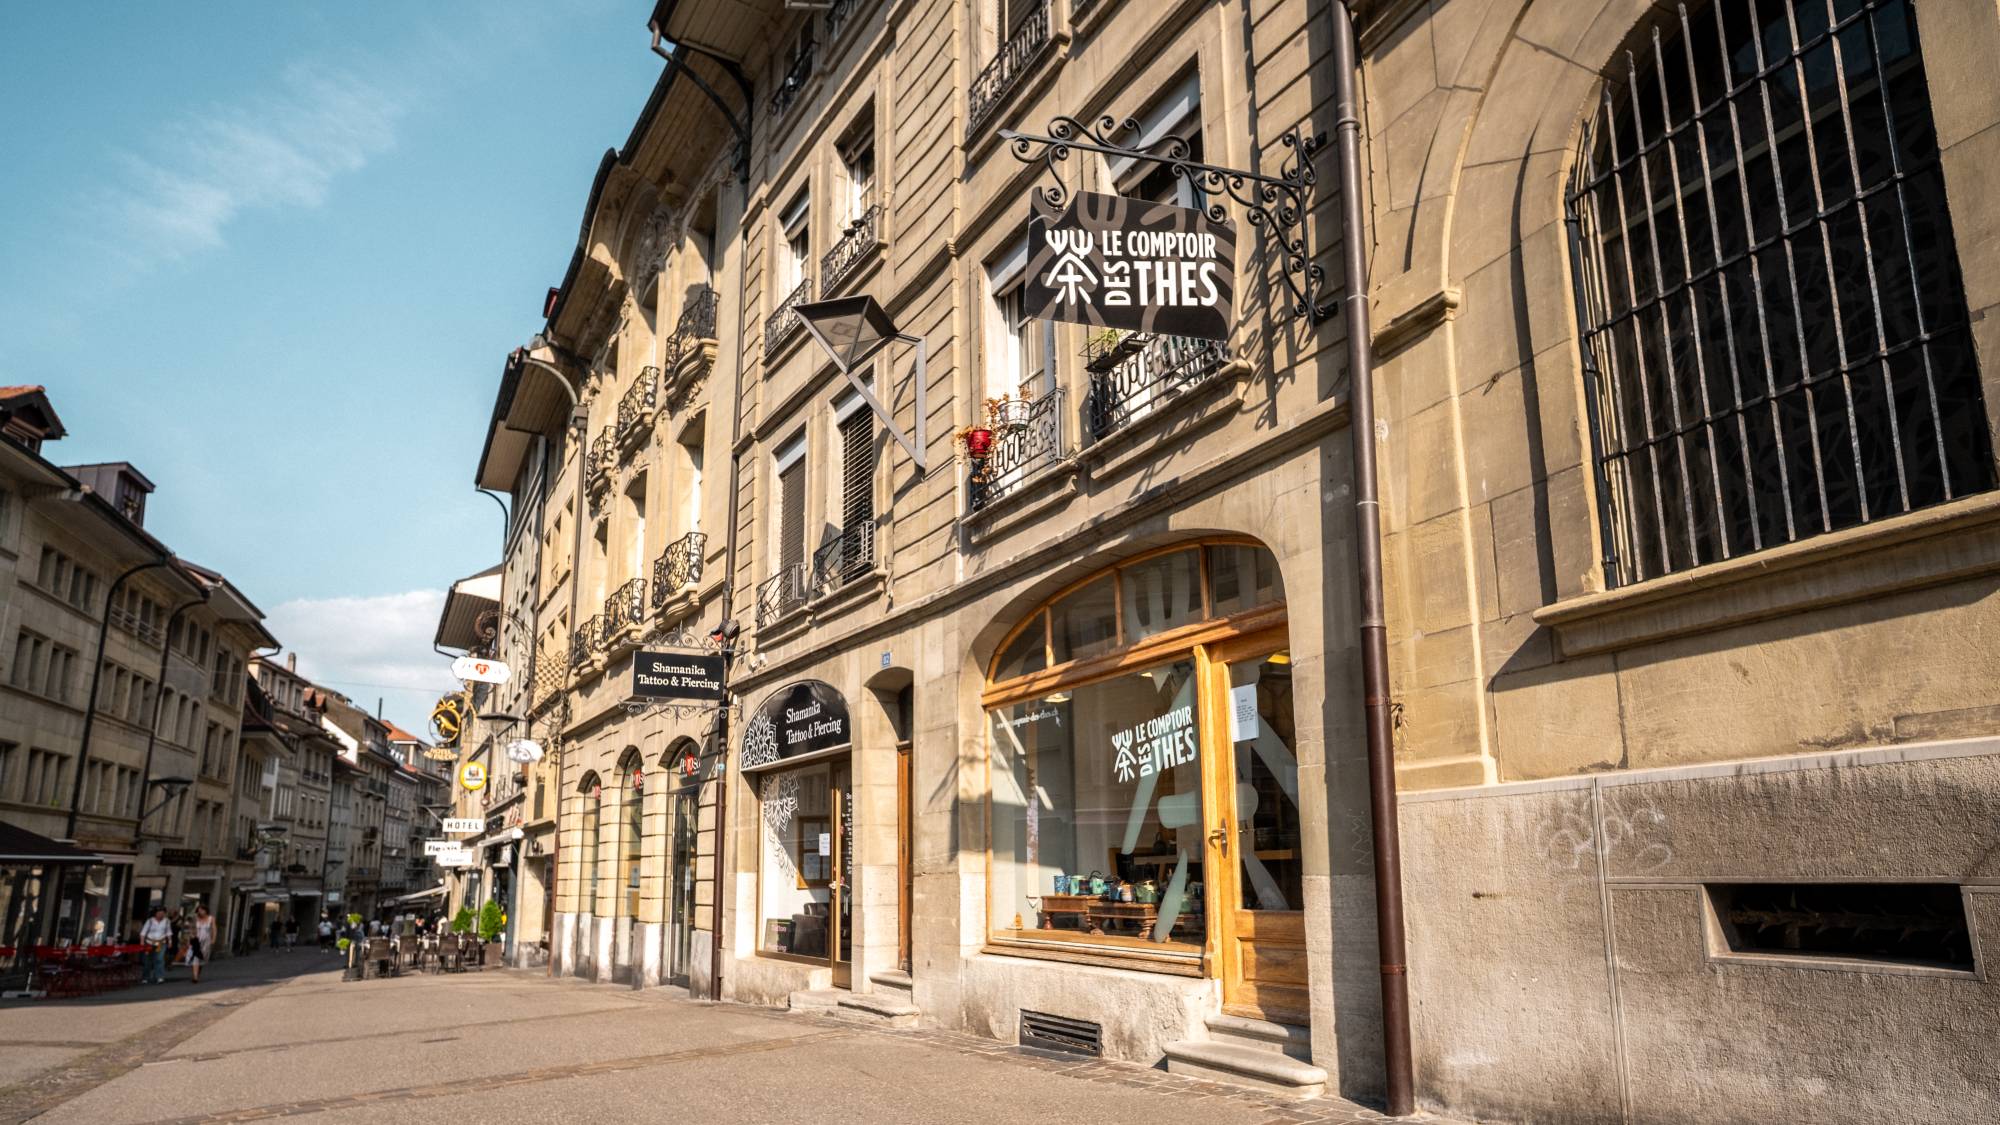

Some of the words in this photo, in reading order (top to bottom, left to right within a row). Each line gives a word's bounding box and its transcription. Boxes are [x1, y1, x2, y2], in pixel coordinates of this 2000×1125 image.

[1103, 230, 1123, 257] LE
[1127, 230, 1217, 258] COMPTOIR
[1103, 261, 1131, 306] DES
[1133, 261, 1219, 307] THES
[638, 675, 669, 686] Tattoo
[670, 676, 679, 686] &
[681, 676, 720, 690] Piercing
[653, 663, 706, 675] Shamanika
[786, 700, 821, 725] Shamanika
[1135, 722, 1147, 743] LE
[1147, 705, 1193, 739] COMPTOIR
[786, 728, 808, 745] Tattoo
[807, 727, 813, 739] &
[814, 717, 842, 737] Piercing
[1137, 742, 1153, 777] DES
[1151, 726, 1197, 773] THES
